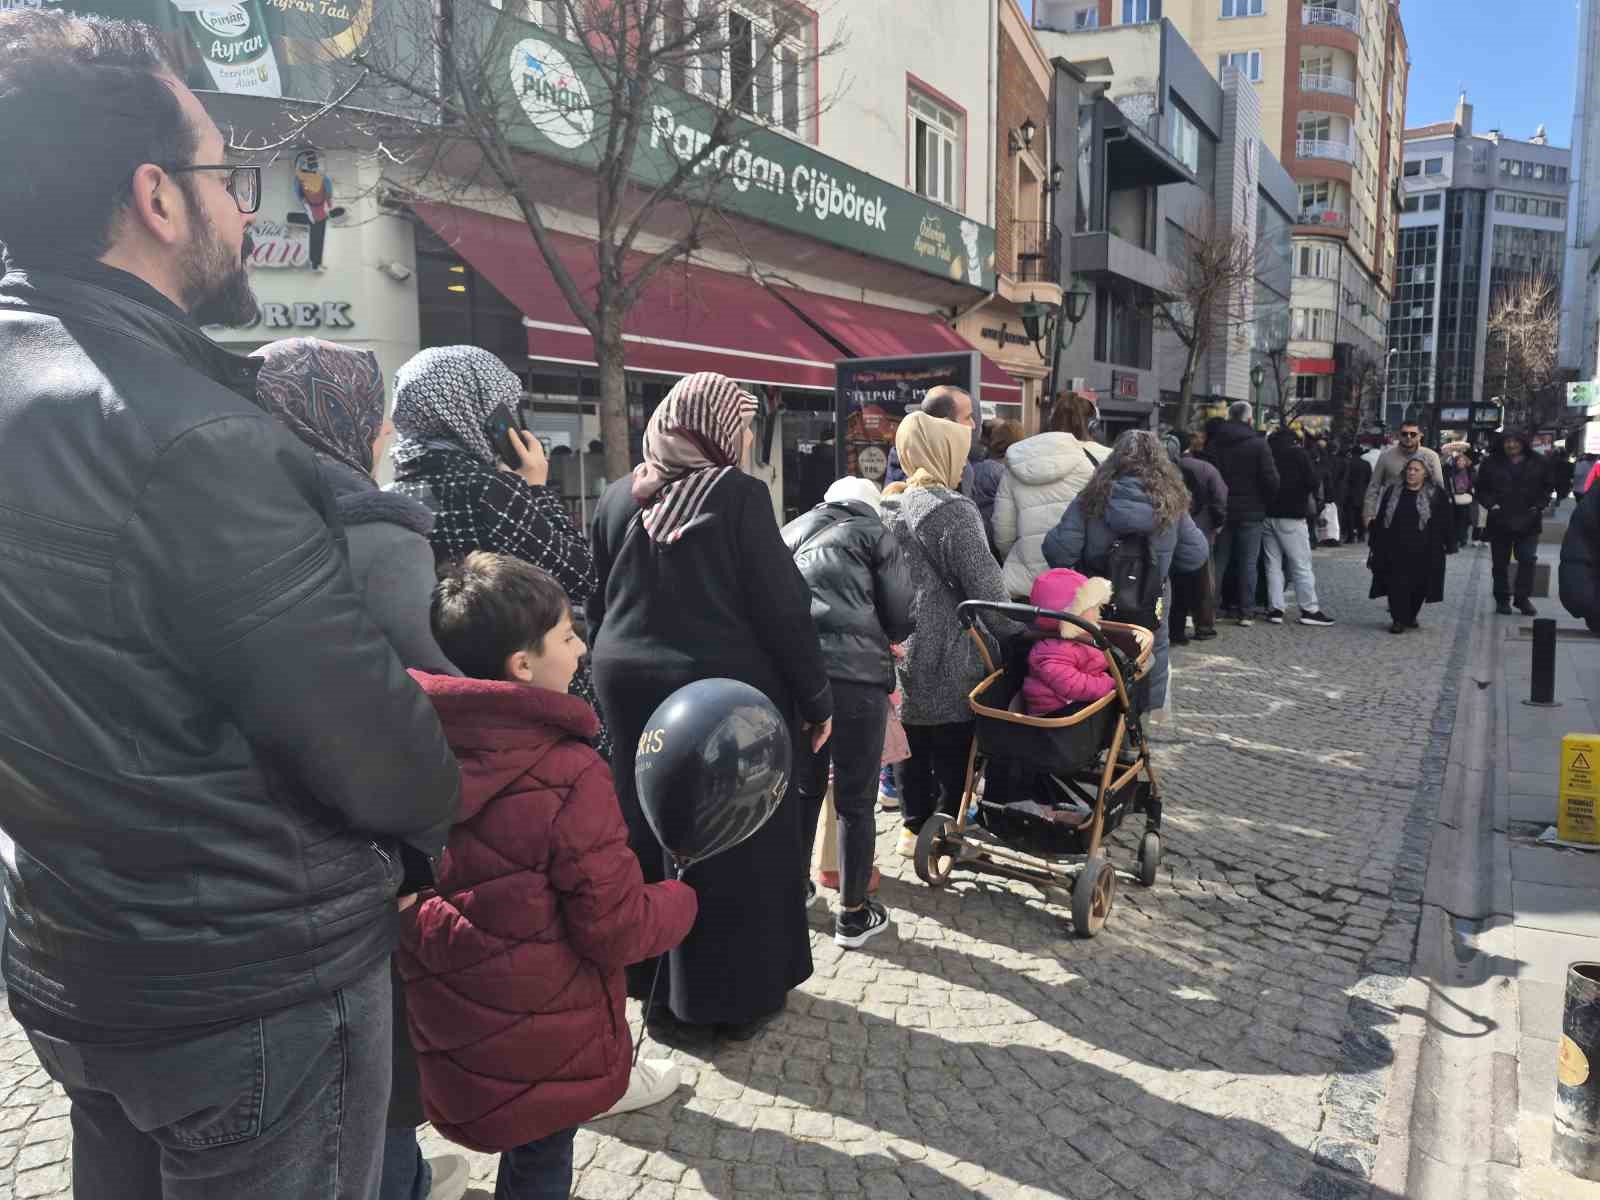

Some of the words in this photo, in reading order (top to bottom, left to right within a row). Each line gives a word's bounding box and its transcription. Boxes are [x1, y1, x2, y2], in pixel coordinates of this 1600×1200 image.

[211, 34, 263, 62] Ayran
[791, 163, 889, 232] Çiğbörek
[637, 728, 665, 755] RIS
